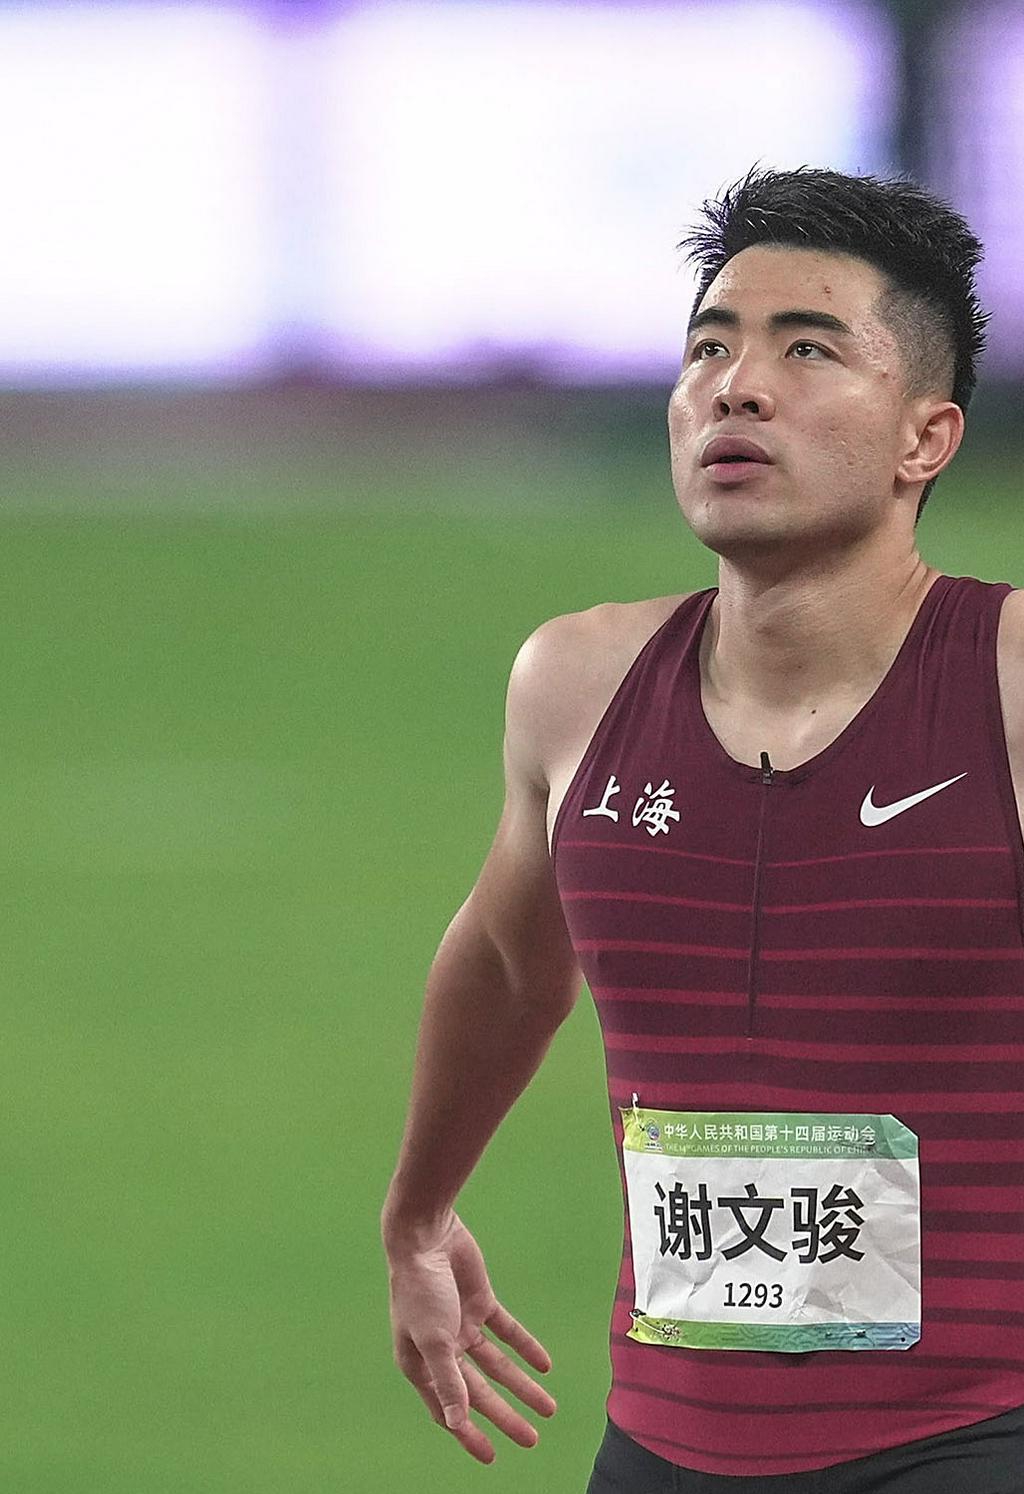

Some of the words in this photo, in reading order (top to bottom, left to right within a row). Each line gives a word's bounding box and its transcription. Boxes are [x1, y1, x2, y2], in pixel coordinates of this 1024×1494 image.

[582, 774, 682, 837] 上海
[664, 1122, 876, 1143] 中华人民共和国第十四届运动会
[692, 1144, 720, 1153] GAMES
[721, 1145, 731, 1153] OF
[733, 1145, 749, 1153] THE
[750, 1145, 788, 1153] PEOPLE'S
[790, 1145, 832, 1154] REPUBLIC
[833, 1146, 846, 1154] OF
[654, 1182, 865, 1264] 谢文骏
[723, 1282, 783, 1308] 1293
